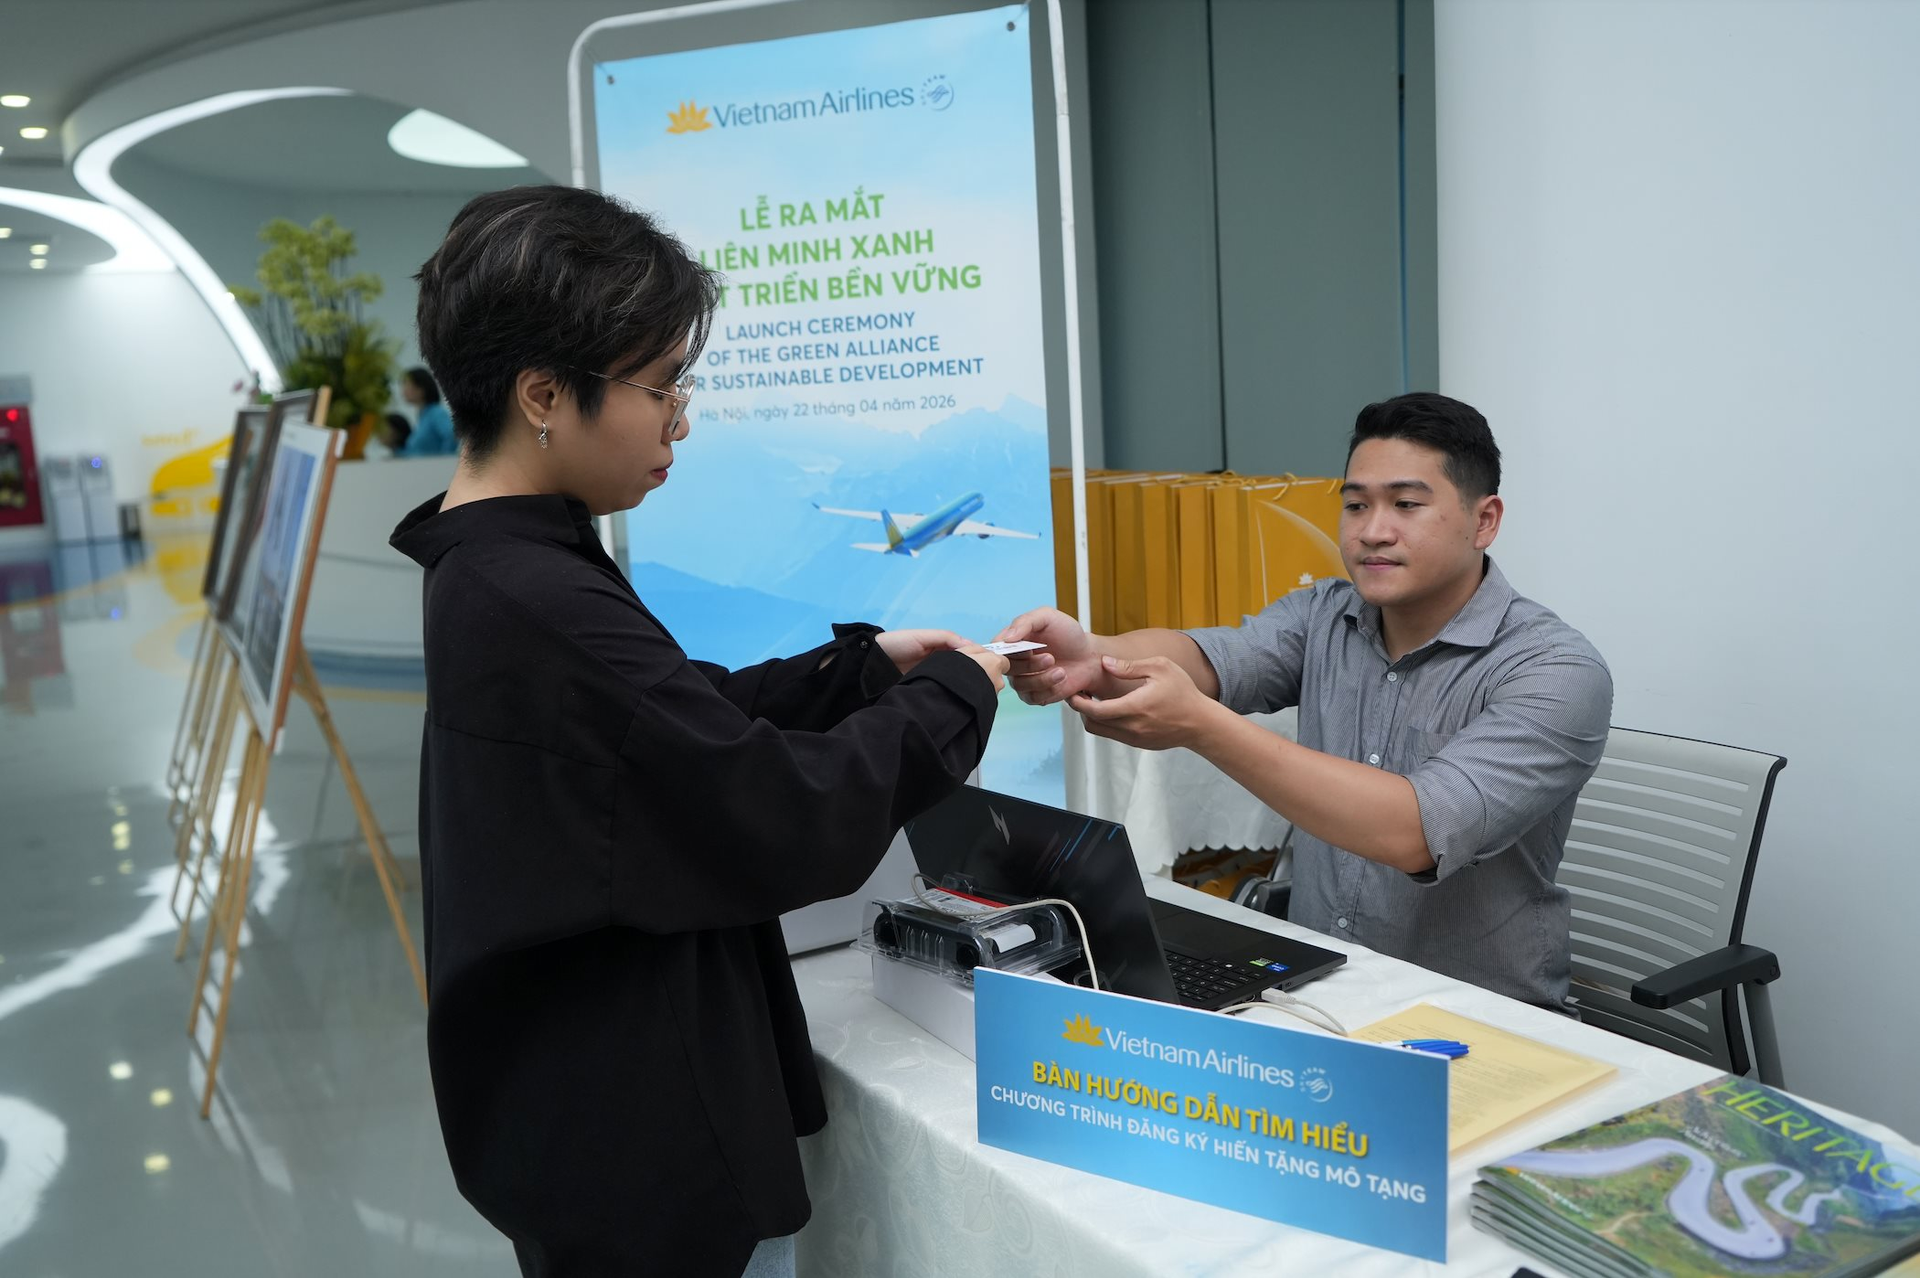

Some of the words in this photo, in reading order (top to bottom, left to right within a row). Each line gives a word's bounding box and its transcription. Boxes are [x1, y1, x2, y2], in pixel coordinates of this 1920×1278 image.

[713, 98, 817, 129] Vietnam
[819, 84, 915, 117] Airlines
[740, 195, 771, 231] LỄ
[780, 202, 817, 227] RA
[825, 186, 884, 222] MẮT
[701, 241, 759, 272] LIÊN
[768, 238, 842, 267] MINH
[851, 229, 934, 259] XANH
[738, 271, 819, 307] TRIỂN
[828, 266, 882, 300] BỀN
[891, 262, 982, 294] VỮNG
[726, 320, 802, 341] LAUNCH
[808, 312, 915, 336] CEREMONY
[707, 350, 731, 367] OF
[737, 347, 771, 364] THE
[777, 342, 840, 362] GREEN
[845, 335, 940, 357] ALLIANCE
[712, 366, 834, 391] SUSTAINABLE
[839, 358, 984, 384] DEVELOPMENT
[754, 405, 789, 421] ngày
[793, 402, 809, 417] 22
[813, 401, 856, 417] tháng
[860, 397, 879, 412] 04
[883, 397, 916, 413] năm
[920, 395, 956, 410] 2026
[1105, 1027, 1200, 1069] Vietnam
[1202, 1049, 1295, 1089] Airlines
[1033, 1060, 1080, 1092] BÀN
[1086, 1073, 1178, 1115] HƯỚNG
[1185, 1093, 1240, 1130] DẪN
[1246, 1108, 1295, 1142] TÌM
[1301, 1122, 1368, 1157] HIỂU
[990, 1085, 1066, 1117] CHƯƠNG
[1070, 1102, 1122, 1132] TRÌNH
[1127, 1117, 1180, 1146] ĐĂNG
[1185, 1130, 1209, 1152] KÝ
[1214, 1137, 1260, 1165] HIẾN
[1265, 1149, 1320, 1178] TẶNG
[1325, 1164, 1361, 1189] MÔ
[1366, 1172, 1427, 1204] TẠNG
[1702, 1080, 1920, 1196] HERITAG
